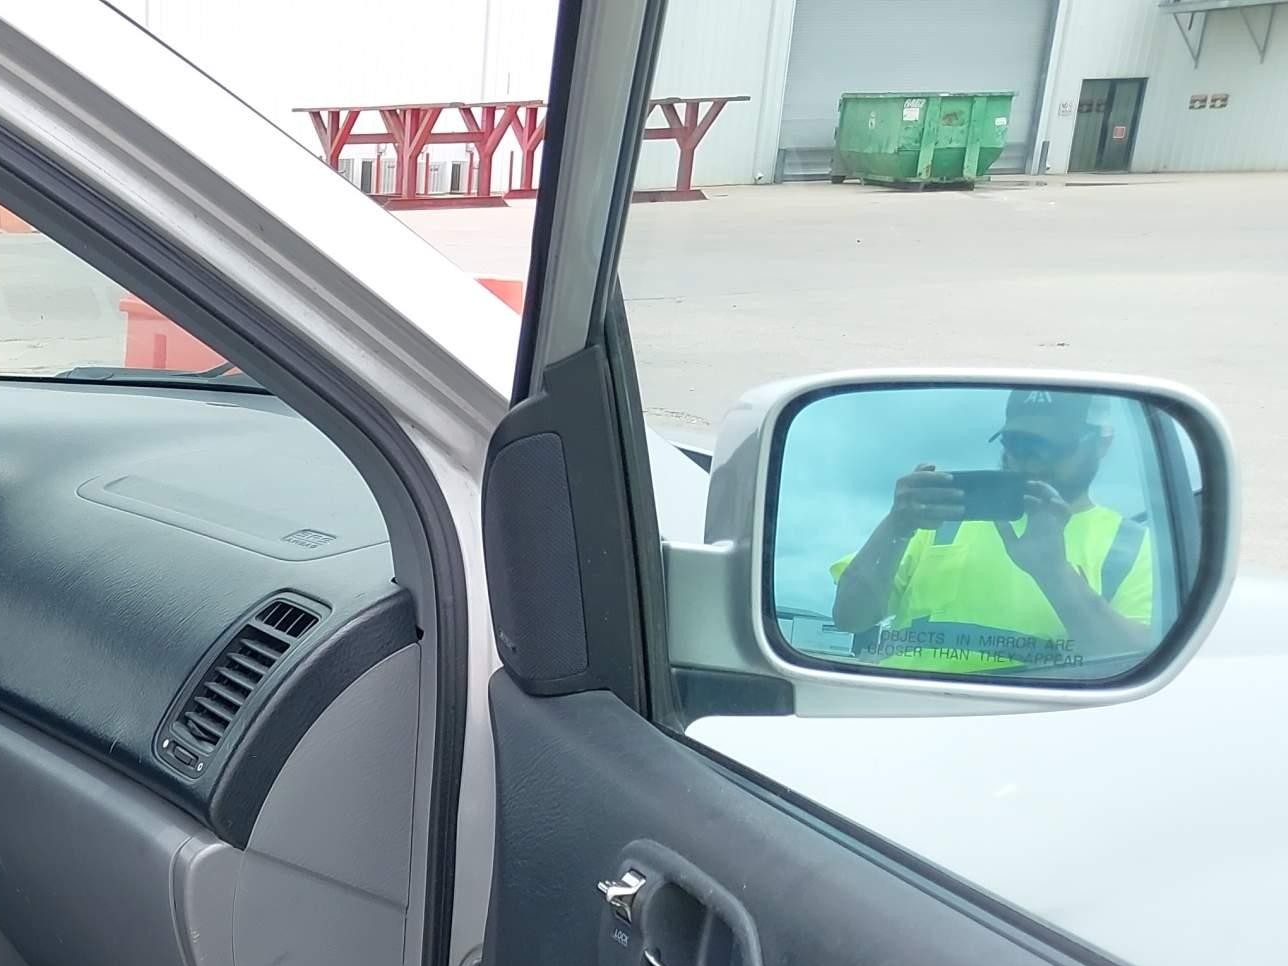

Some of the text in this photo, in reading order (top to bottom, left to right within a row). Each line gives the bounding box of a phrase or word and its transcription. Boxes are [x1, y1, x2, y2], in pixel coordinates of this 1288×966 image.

[881, 630, 1075, 651] OBJECTS IN MIRROR ARE
[932, 647, 970, 661] THAN
[980, 650, 1014, 663] THEY
[1026, 652, 1084, 667] APPEAR
